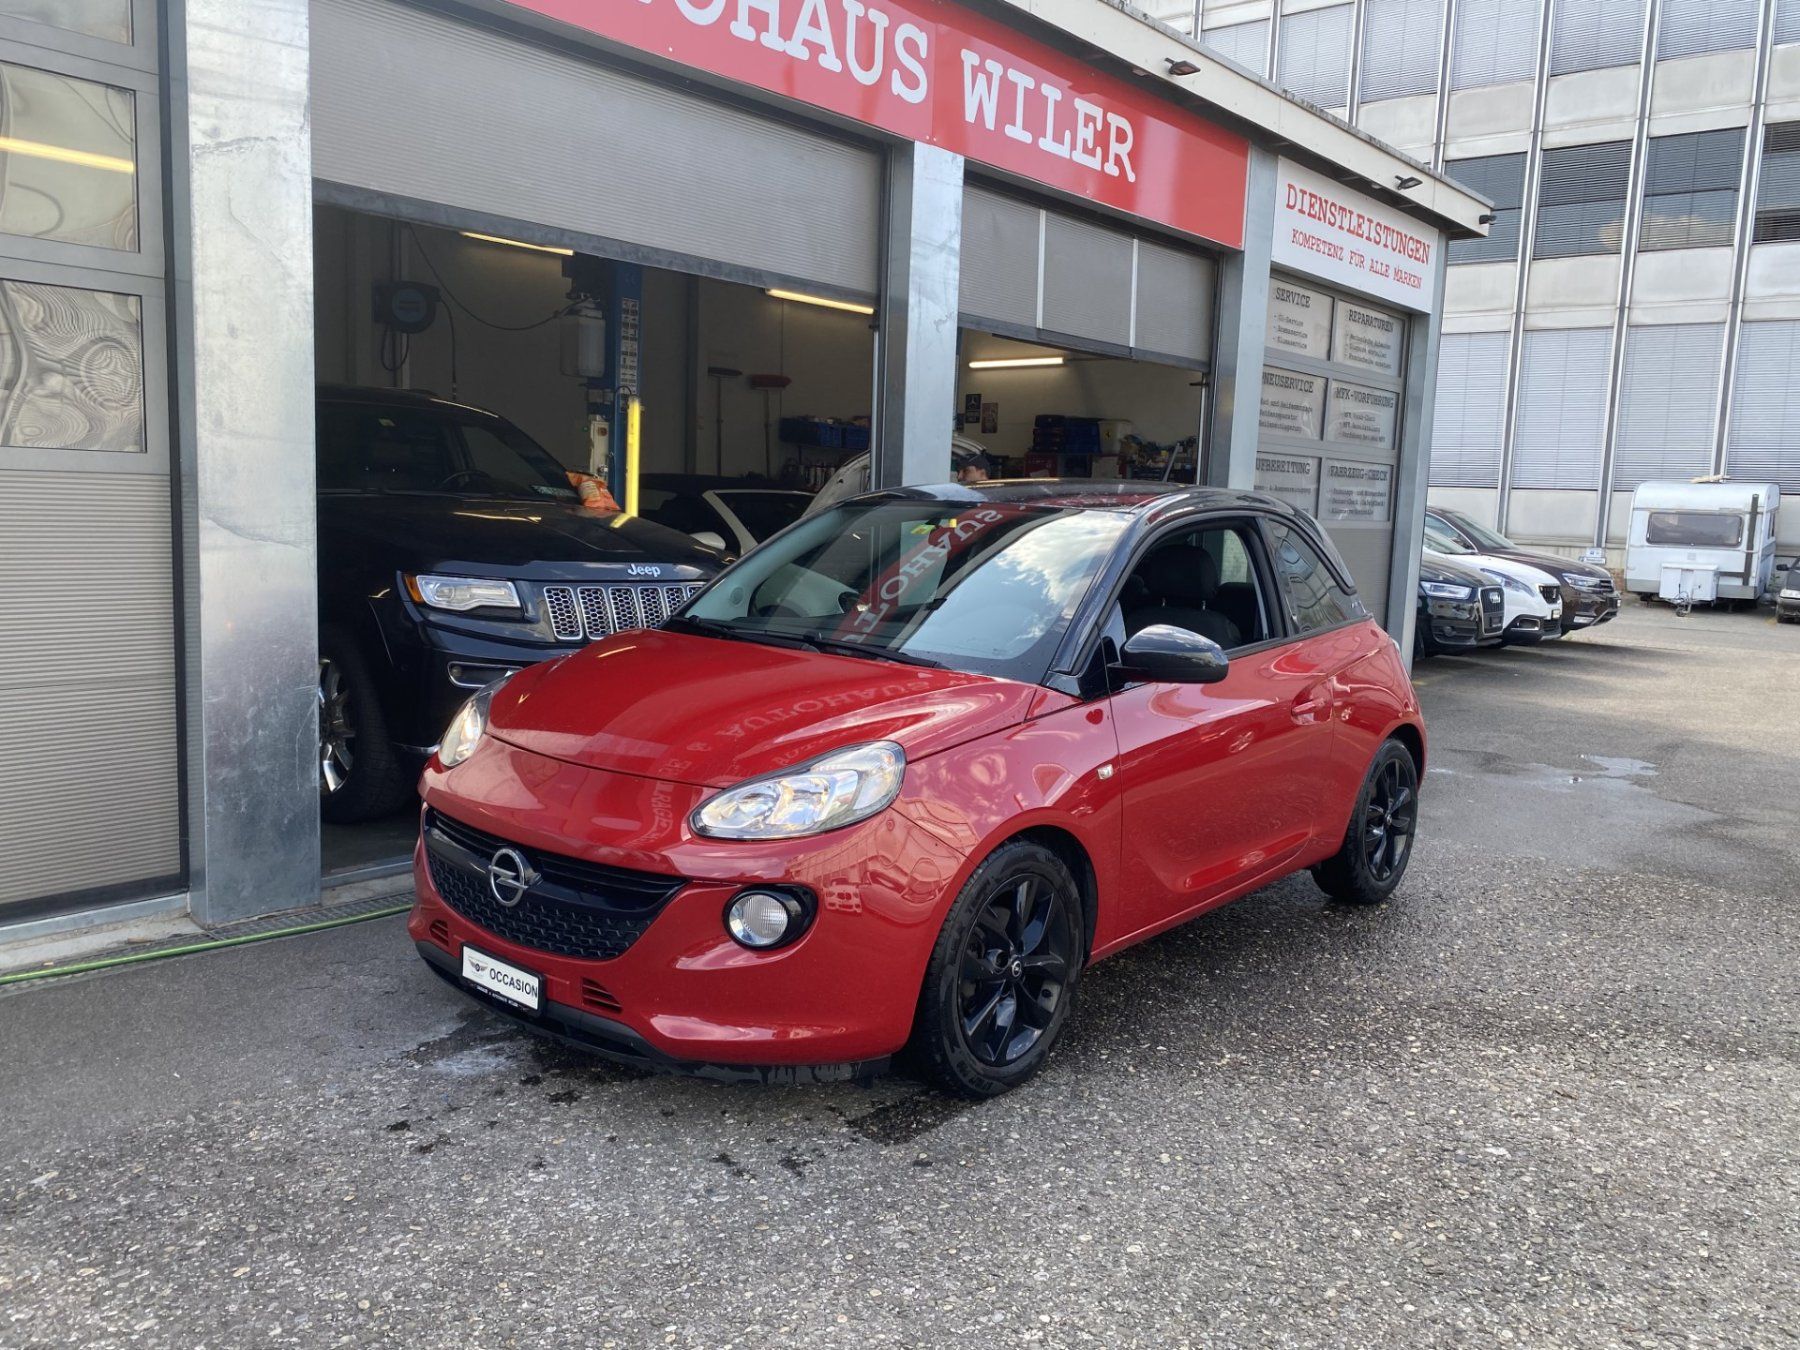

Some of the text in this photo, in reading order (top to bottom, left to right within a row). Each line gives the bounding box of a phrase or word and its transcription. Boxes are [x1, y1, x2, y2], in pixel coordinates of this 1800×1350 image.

[960, 48, 1136, 183] WILER
[1286, 183, 1430, 265] DIENSTLEISTUNGEN
[1291, 228, 1423, 289] KOMPETENZ FÜR ALLE MARKEN
[1275, 287, 1310, 308] SERVICE
[1348, 309, 1394, 332] REPARATUREN
[1262, 371, 1314, 394] NEUSERVICE
[628, 563, 661, 577] Jeep
[489, 968, 538, 998] OCCASION
